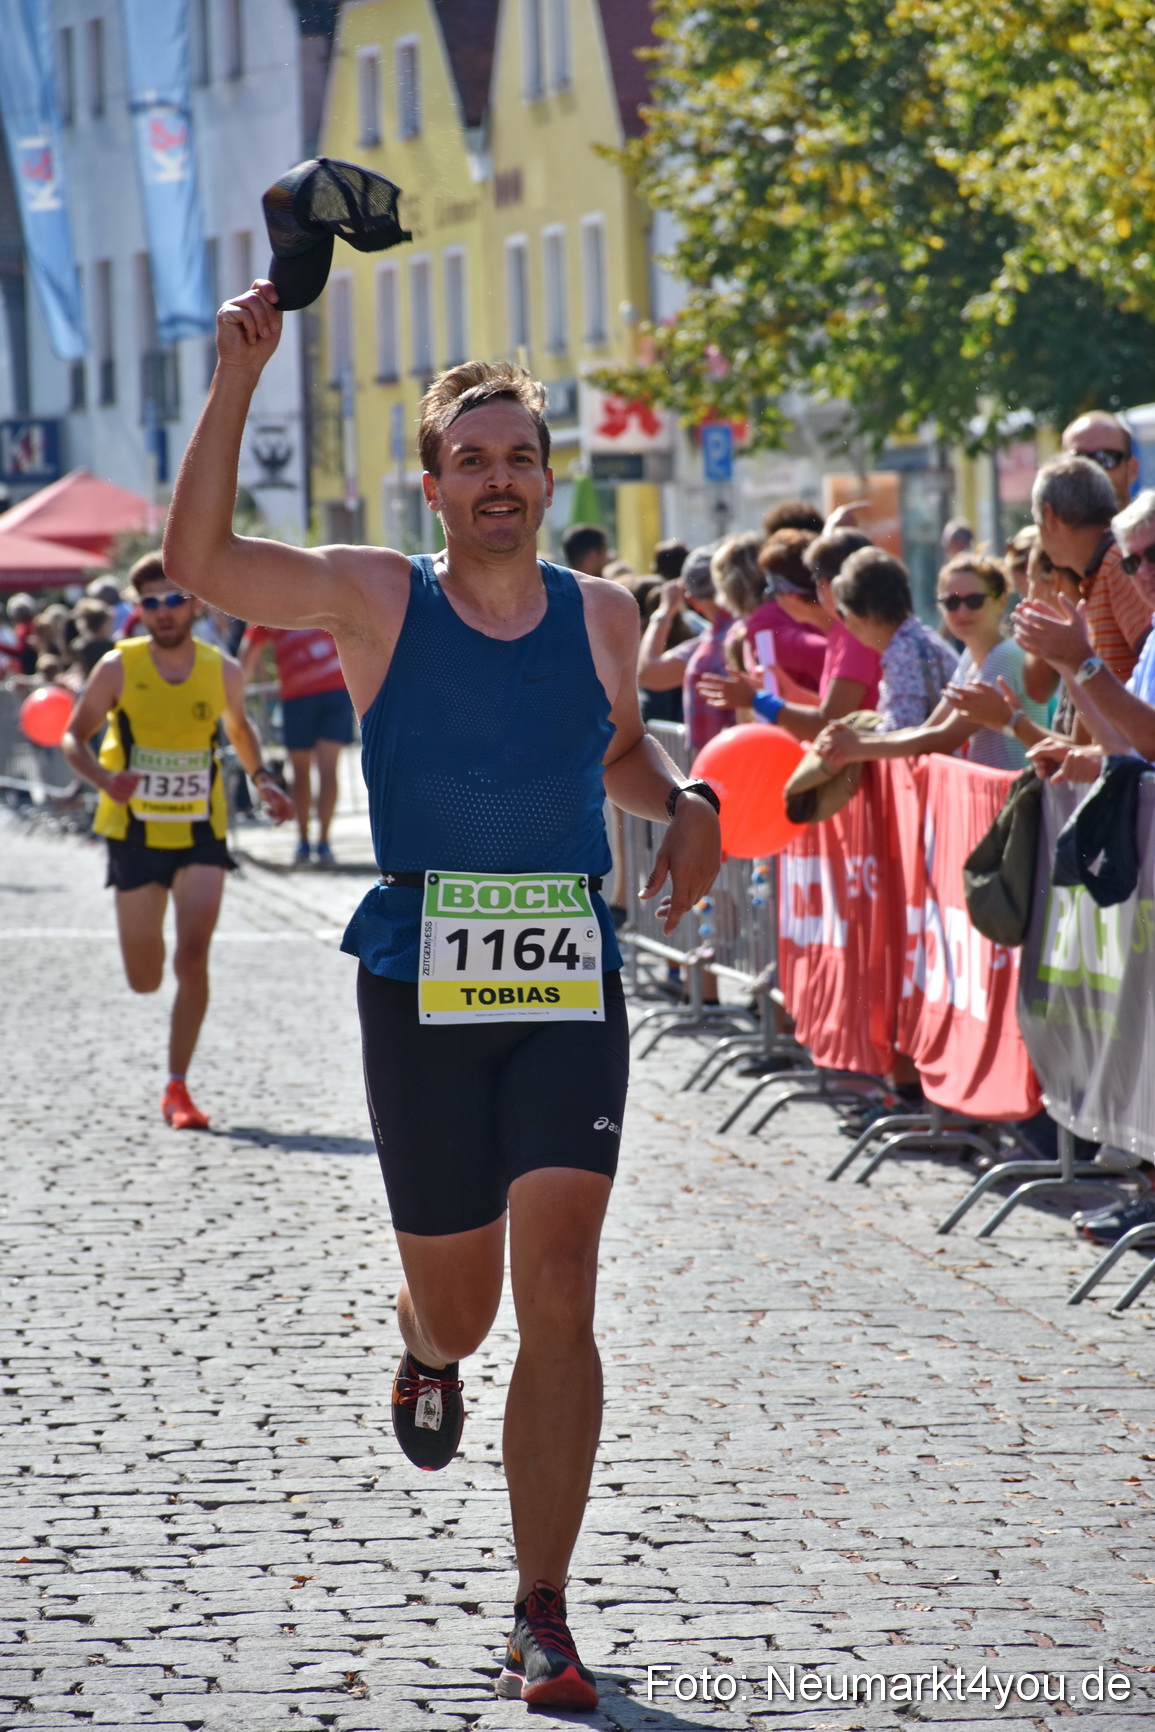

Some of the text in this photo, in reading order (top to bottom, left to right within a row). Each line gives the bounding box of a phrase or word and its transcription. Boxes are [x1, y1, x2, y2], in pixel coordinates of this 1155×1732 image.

[140, 754, 201, 768] BOCK
[143, 774, 200, 797] 1325
[440, 881, 582, 911] BOCK
[586, 929, 594, 939] C
[445, 927, 580, 972] 1164
[460, 986, 561, 1006] TOBIAS
